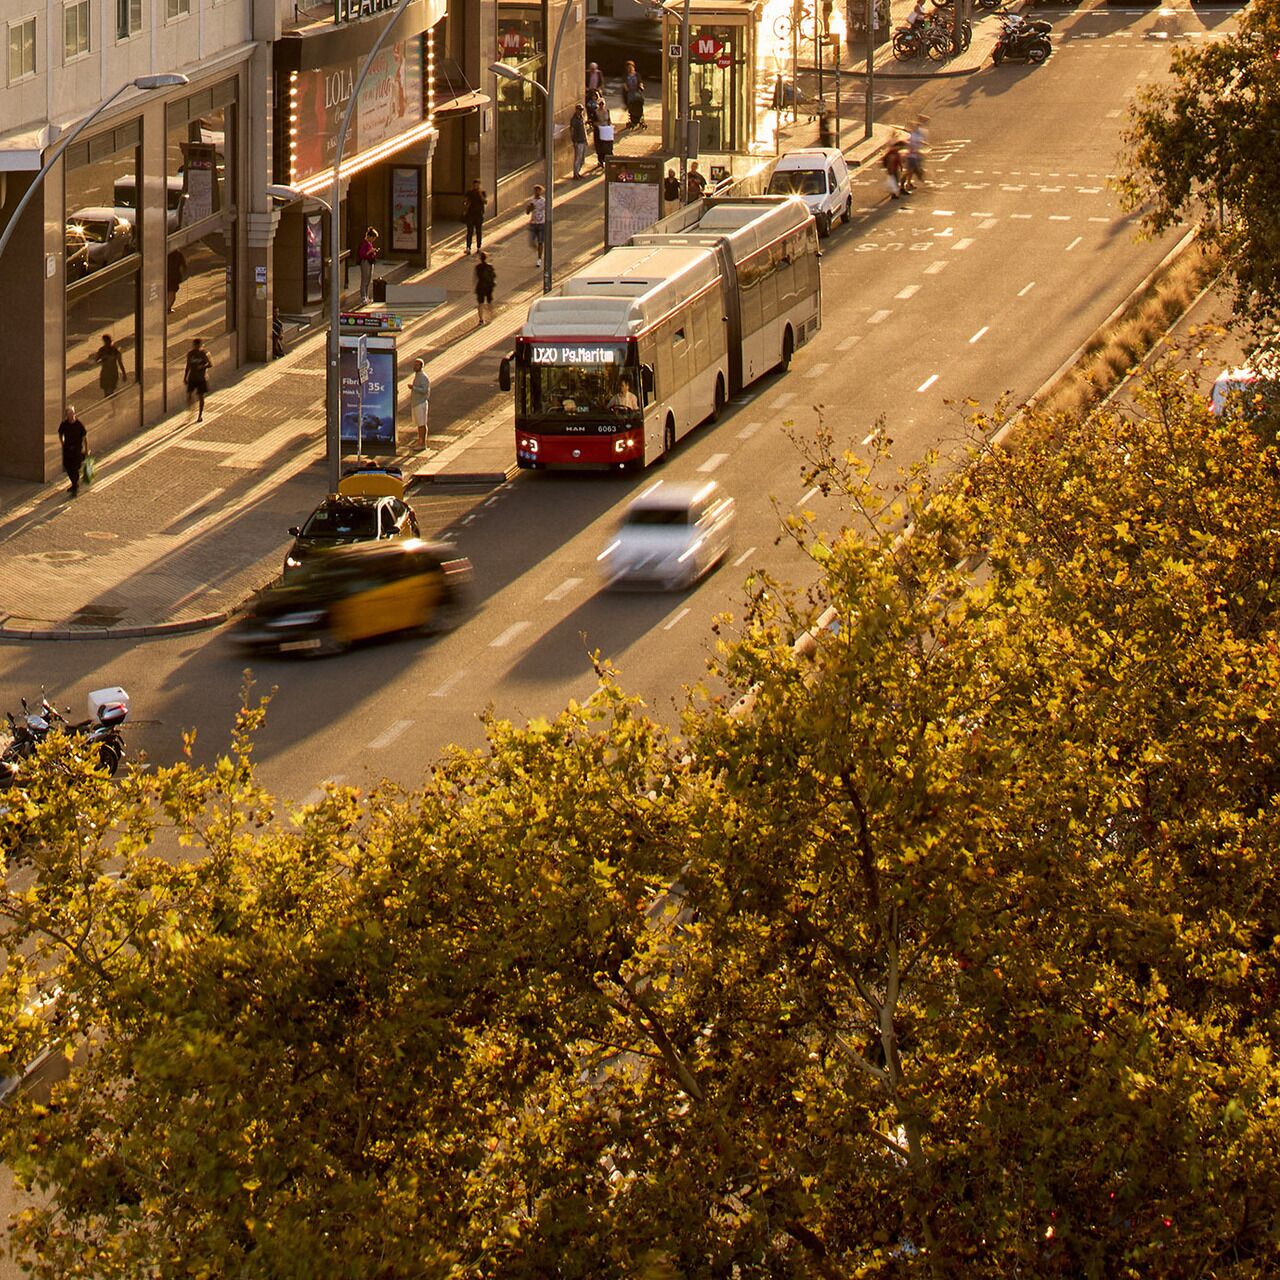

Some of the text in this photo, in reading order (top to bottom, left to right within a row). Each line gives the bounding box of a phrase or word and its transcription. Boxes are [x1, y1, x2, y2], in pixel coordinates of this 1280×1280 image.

[698, 40, 714, 54] M
[325, 67, 354, 109] LOLA
[597, 425, 617, 433] 6063
